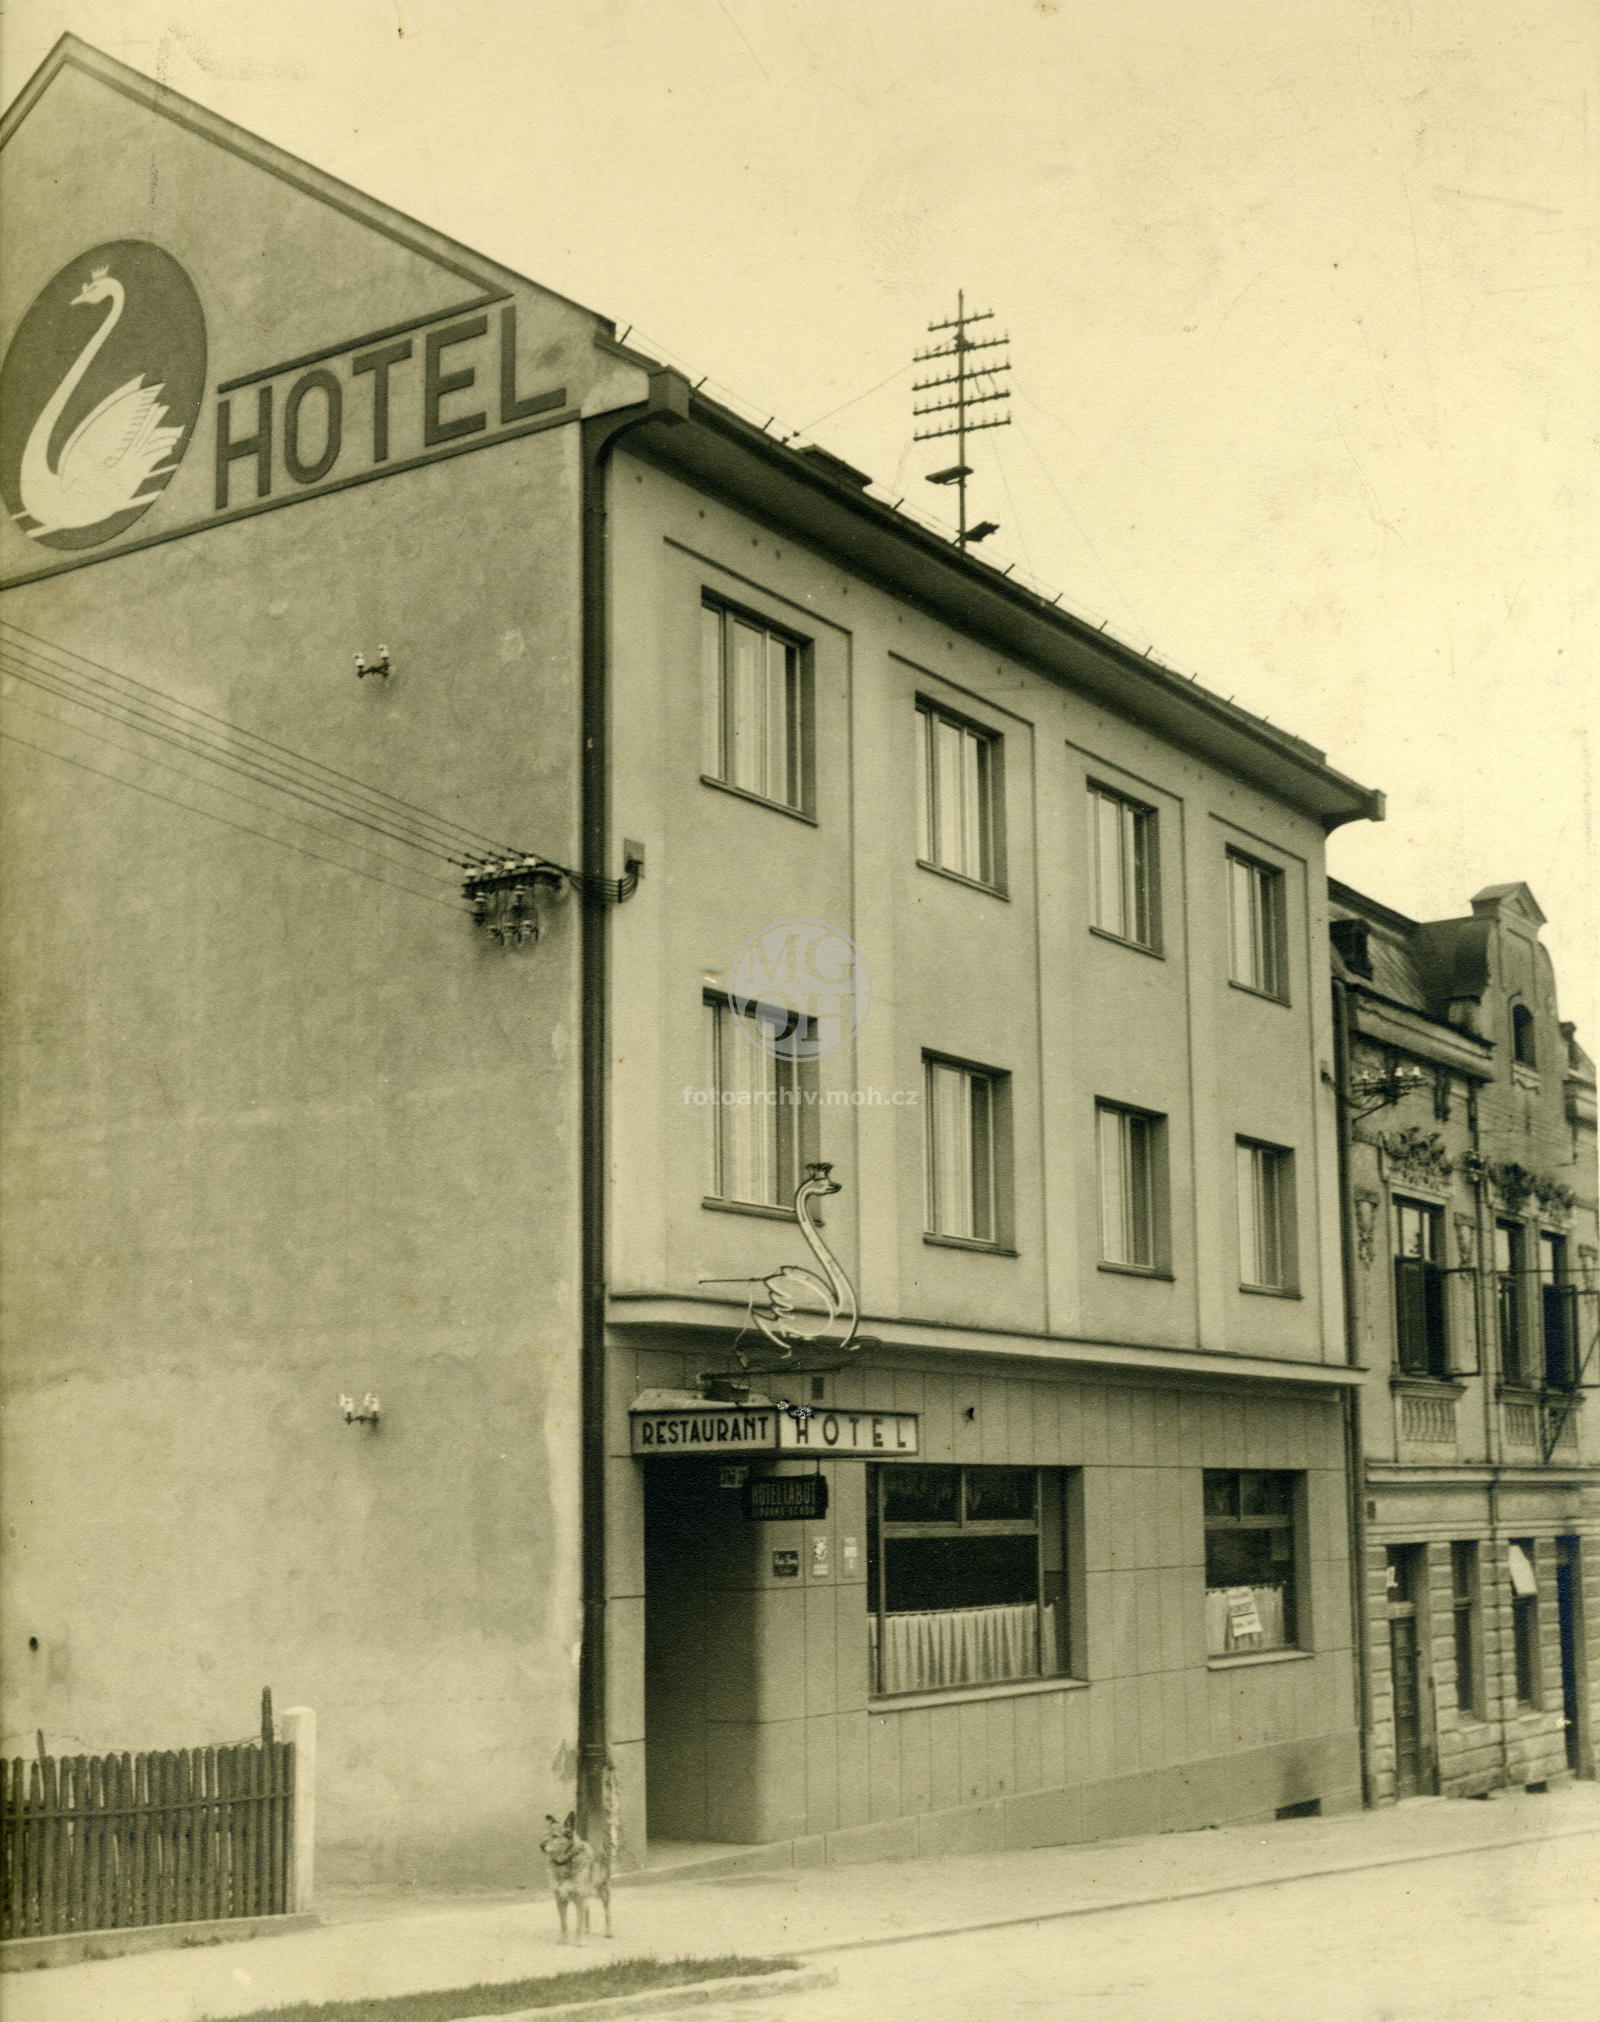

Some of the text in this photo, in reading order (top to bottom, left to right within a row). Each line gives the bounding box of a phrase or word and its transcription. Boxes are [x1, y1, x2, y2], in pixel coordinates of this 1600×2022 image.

[215, 304, 567, 510] HOTEL
[642, 1413, 906, 1448] RESTAURANT HOTEL
